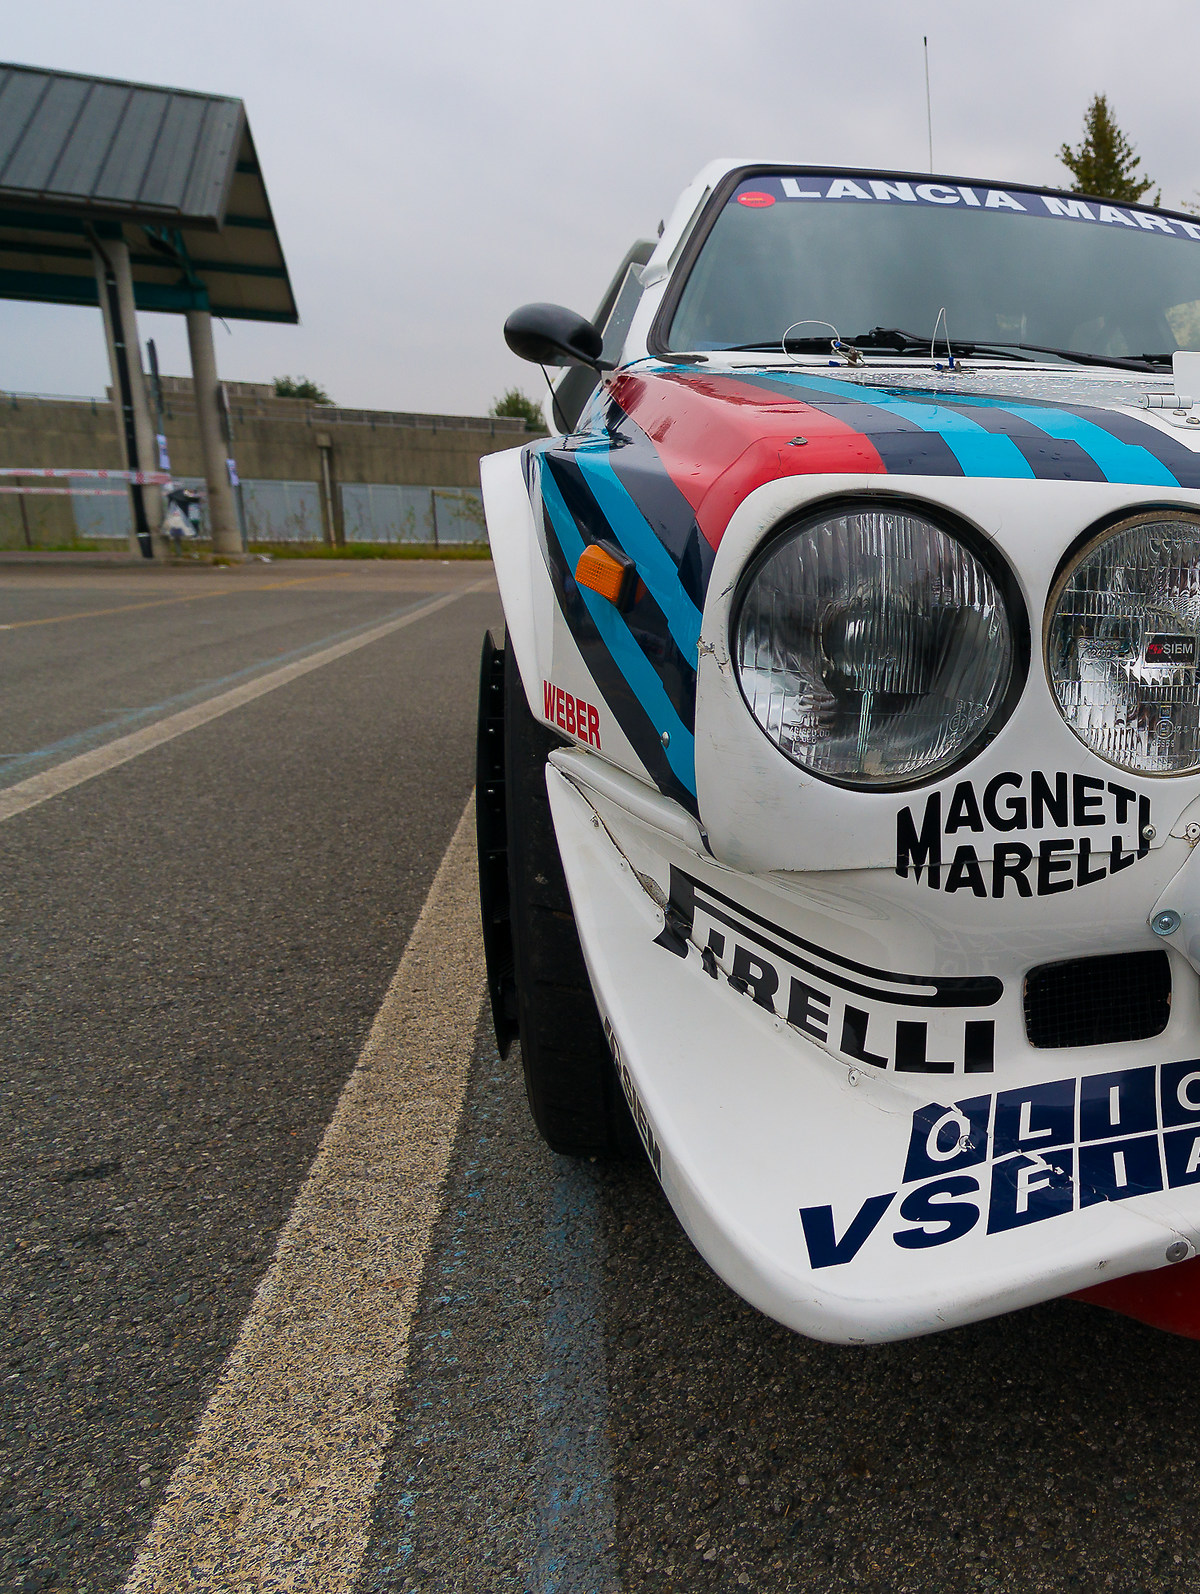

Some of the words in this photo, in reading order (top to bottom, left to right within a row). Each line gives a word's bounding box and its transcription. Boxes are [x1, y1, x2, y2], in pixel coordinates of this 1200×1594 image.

[779, 178, 1027, 212] LANCIA
[1162, 643, 1193, 655] SIEM
[543, 679, 602, 751] WEBER
[896, 770, 1151, 855] MAGNETI
[896, 818, 1151, 899] MARELLI
[652, 863, 1004, 1074] PIRELLI
